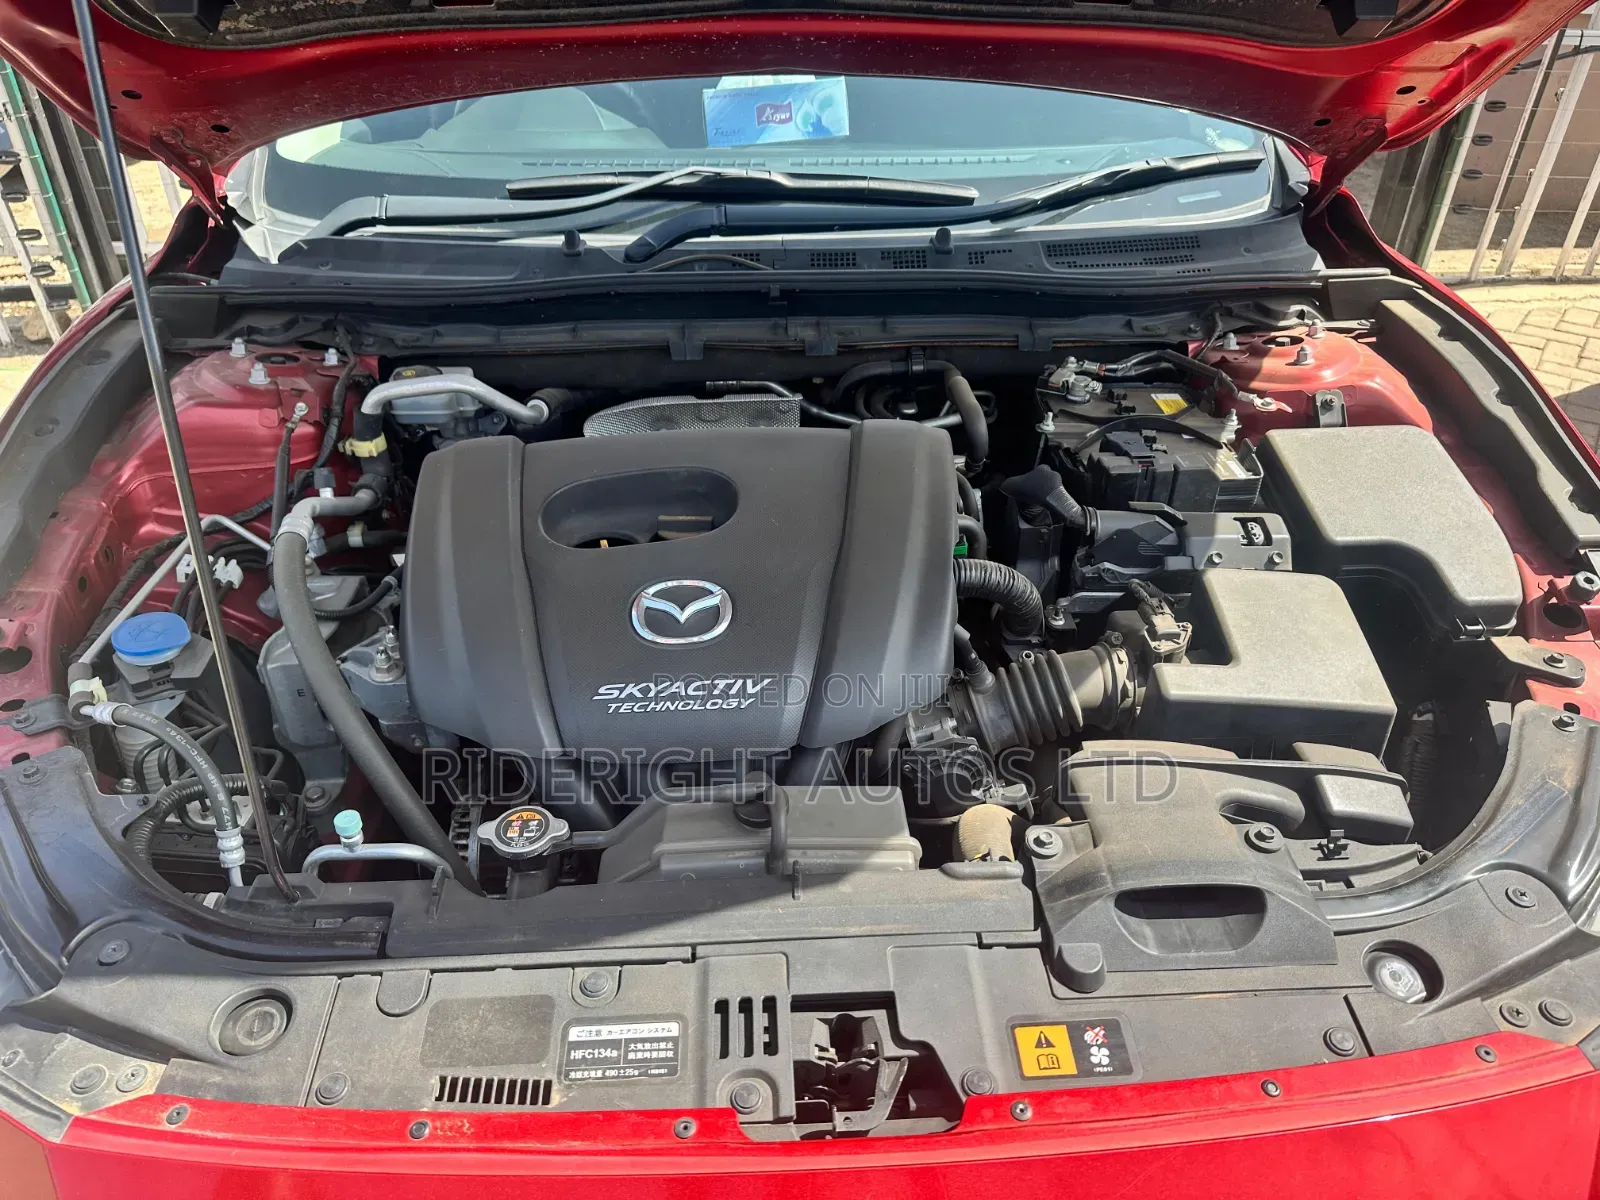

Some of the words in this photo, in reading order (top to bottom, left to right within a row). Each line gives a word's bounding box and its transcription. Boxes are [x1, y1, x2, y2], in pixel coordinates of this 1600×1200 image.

[593, 678, 773, 700] SKYACTIV
[607, 698, 756, 714] TECHNOLOGY
[570, 1048, 618, 1060] HFC134a
